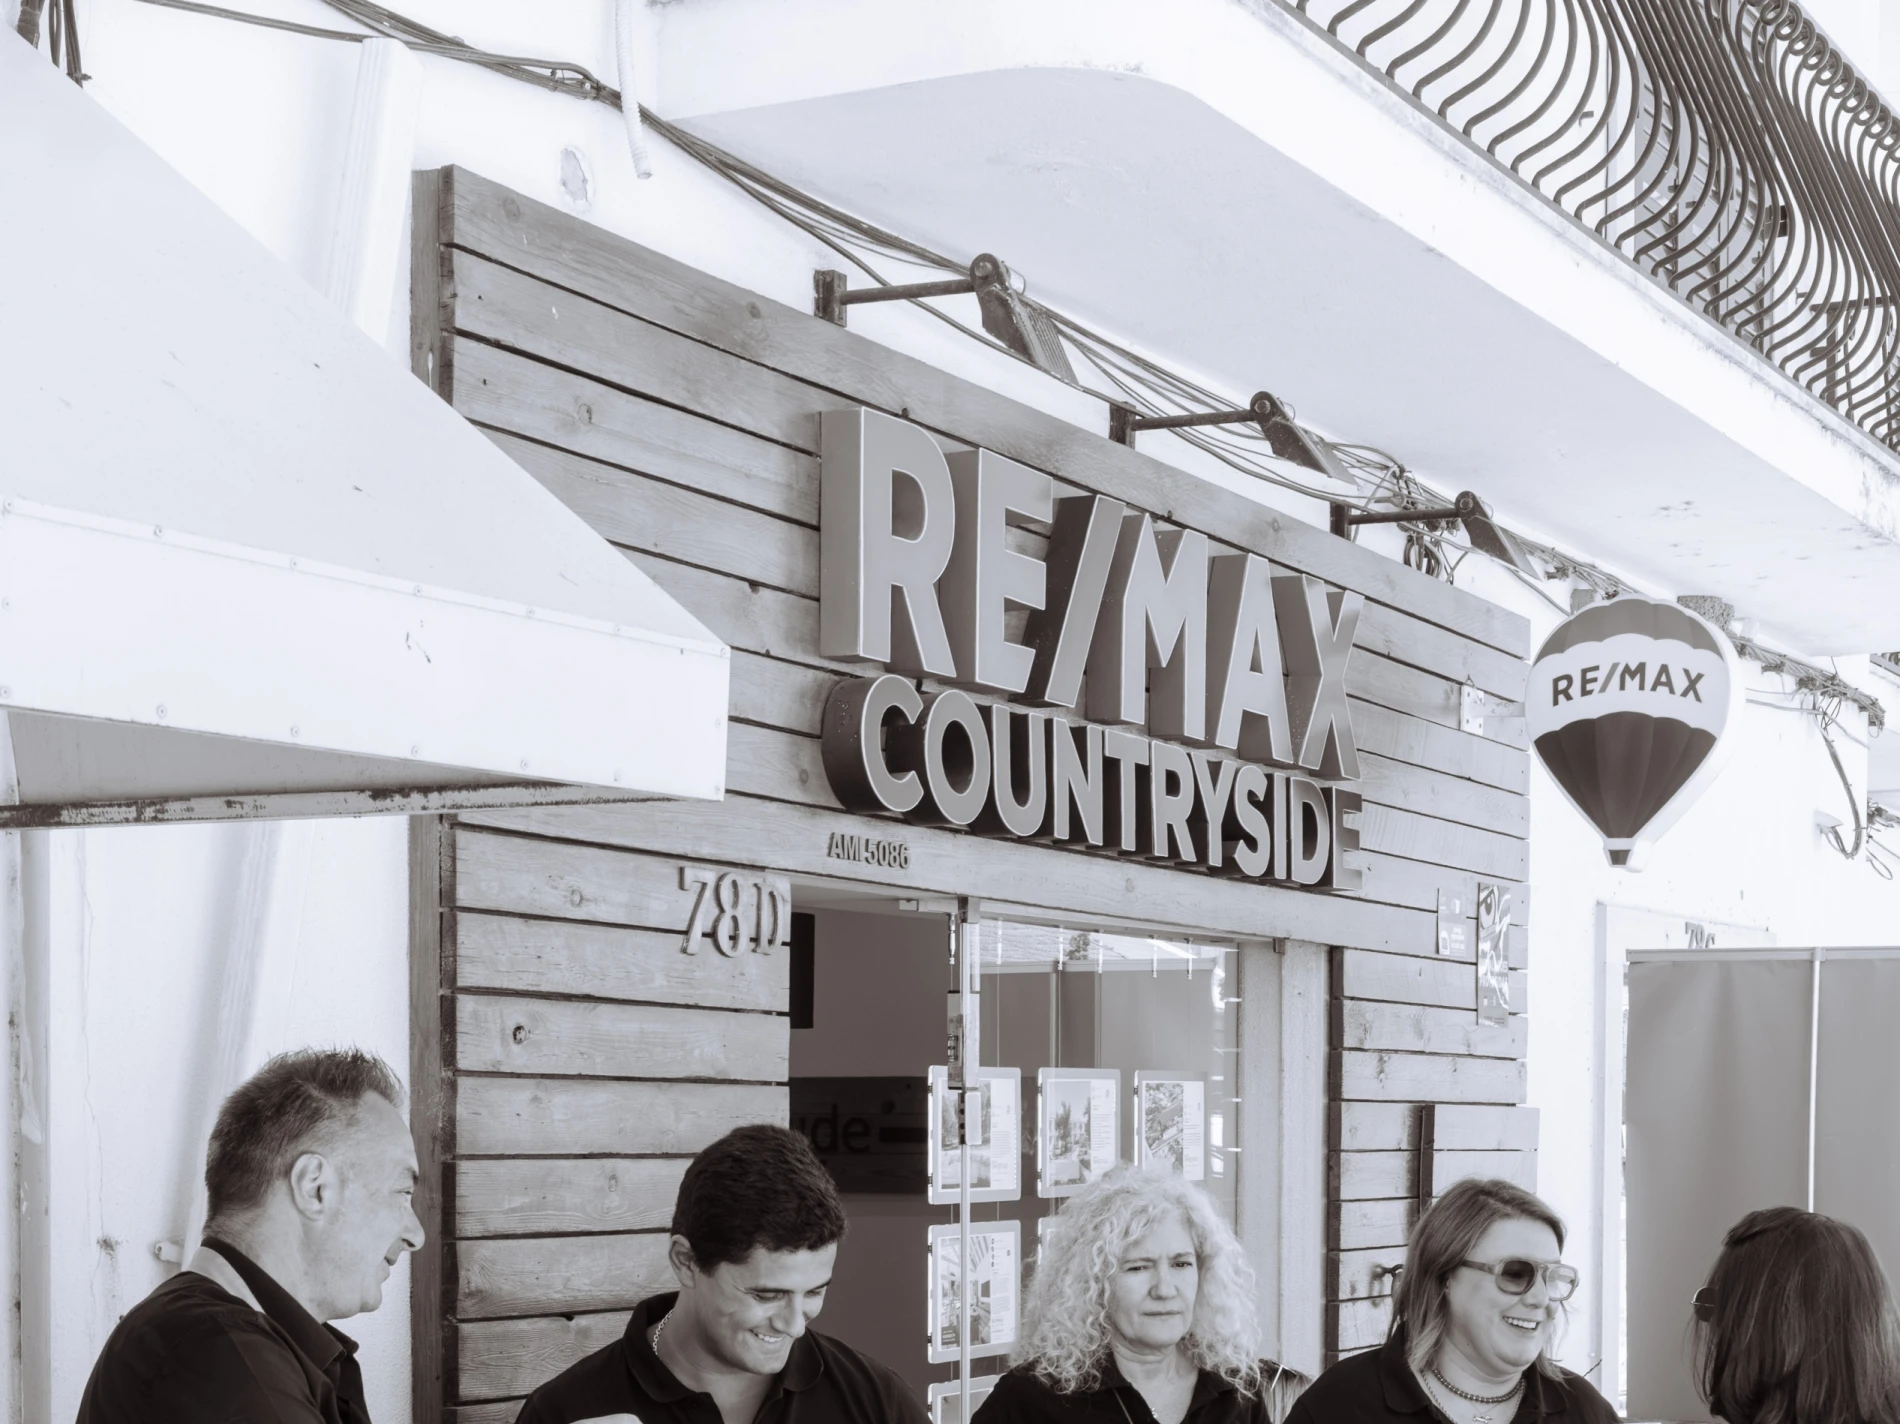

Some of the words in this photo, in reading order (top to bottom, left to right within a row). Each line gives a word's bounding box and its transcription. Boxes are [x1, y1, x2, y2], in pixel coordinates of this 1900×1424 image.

[856, 406, 1365, 780] RE/MAX
[1552, 661, 1706, 707] RE/MAX
[856, 675, 1363, 890] COUNTRYSIDE
[829, 832, 865, 862] AMI
[864, 838, 911, 869] 5086
[678, 866, 784, 957] 78D
